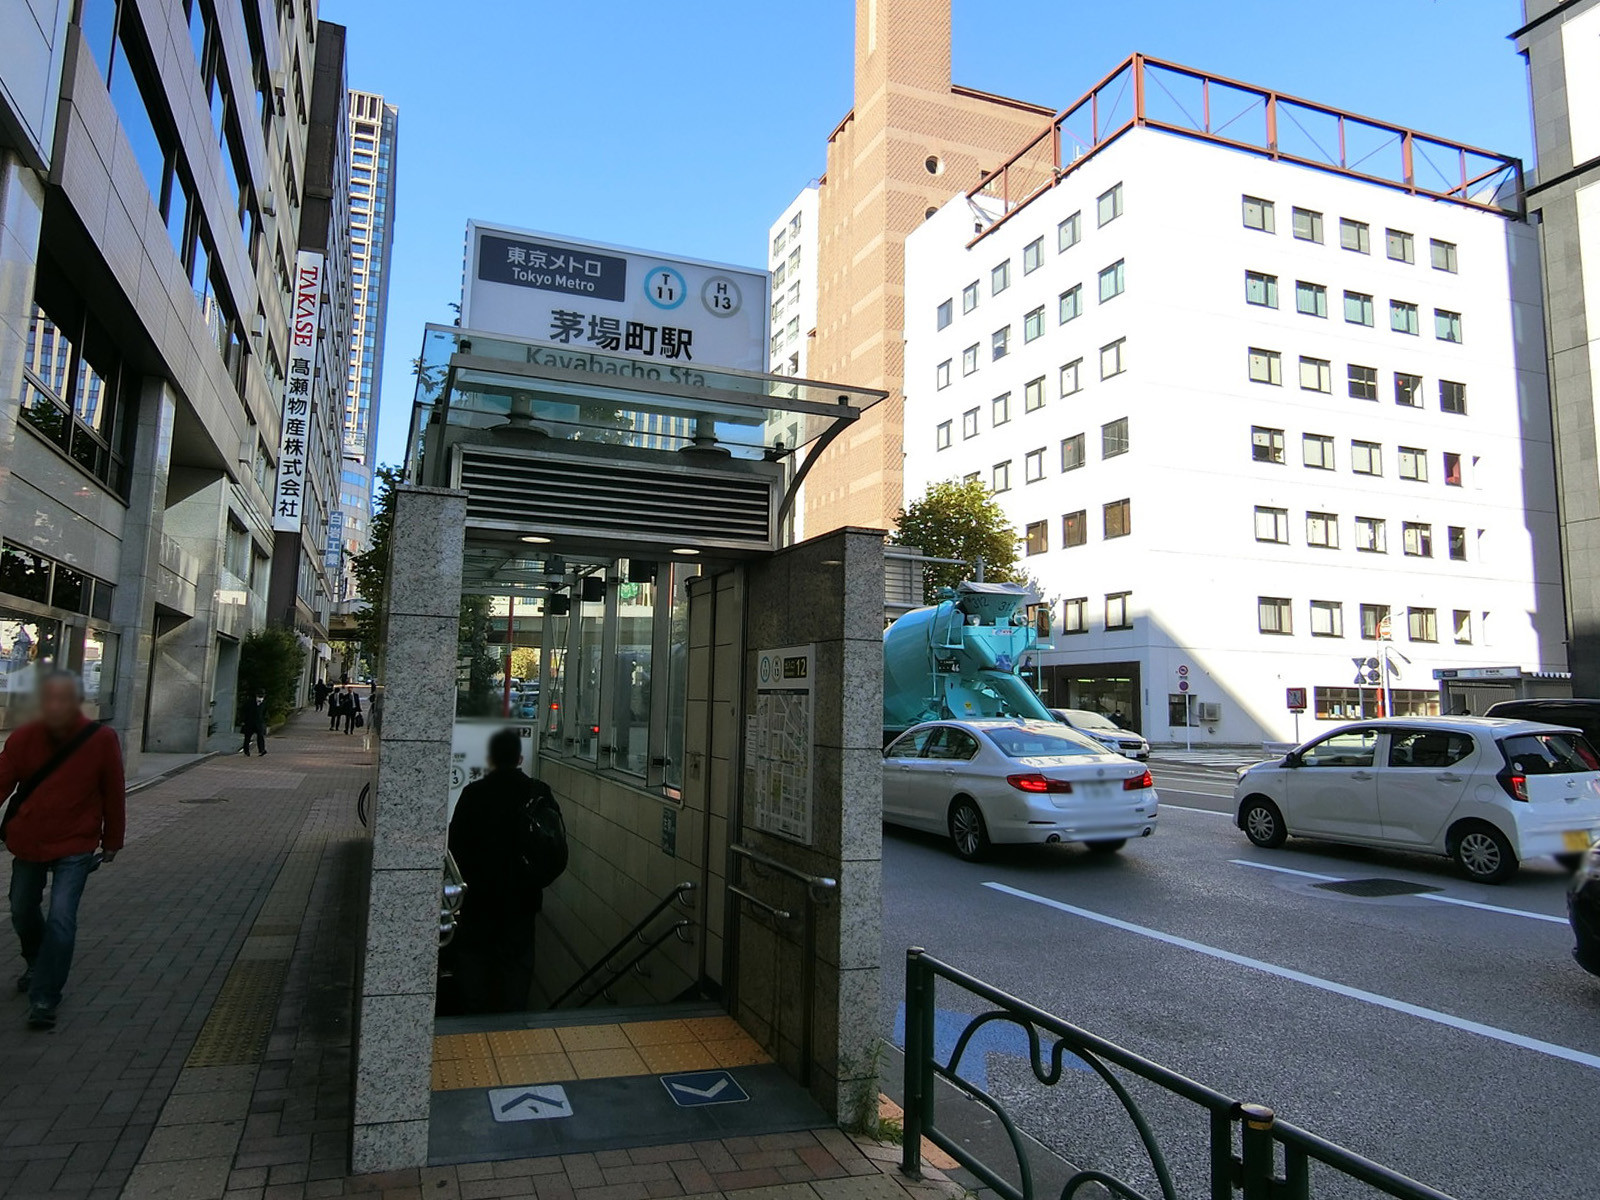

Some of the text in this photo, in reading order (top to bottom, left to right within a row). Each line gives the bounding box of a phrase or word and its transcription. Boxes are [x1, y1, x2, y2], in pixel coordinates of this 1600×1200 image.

[507, 246, 601, 277] 東京メトロ
[512, 267, 595, 293] Tokyo Metro
[662, 273, 670, 285] T
[717, 282, 728, 295] H
[657, 286, 674, 301] 11
[713, 295, 731, 310] 13
[294, 266, 318, 348] TAKASE
[550, 309, 693, 361] 茅場町駅
[526, 346, 661, 383] Kayabacho
[796, 658, 806, 676] 12
